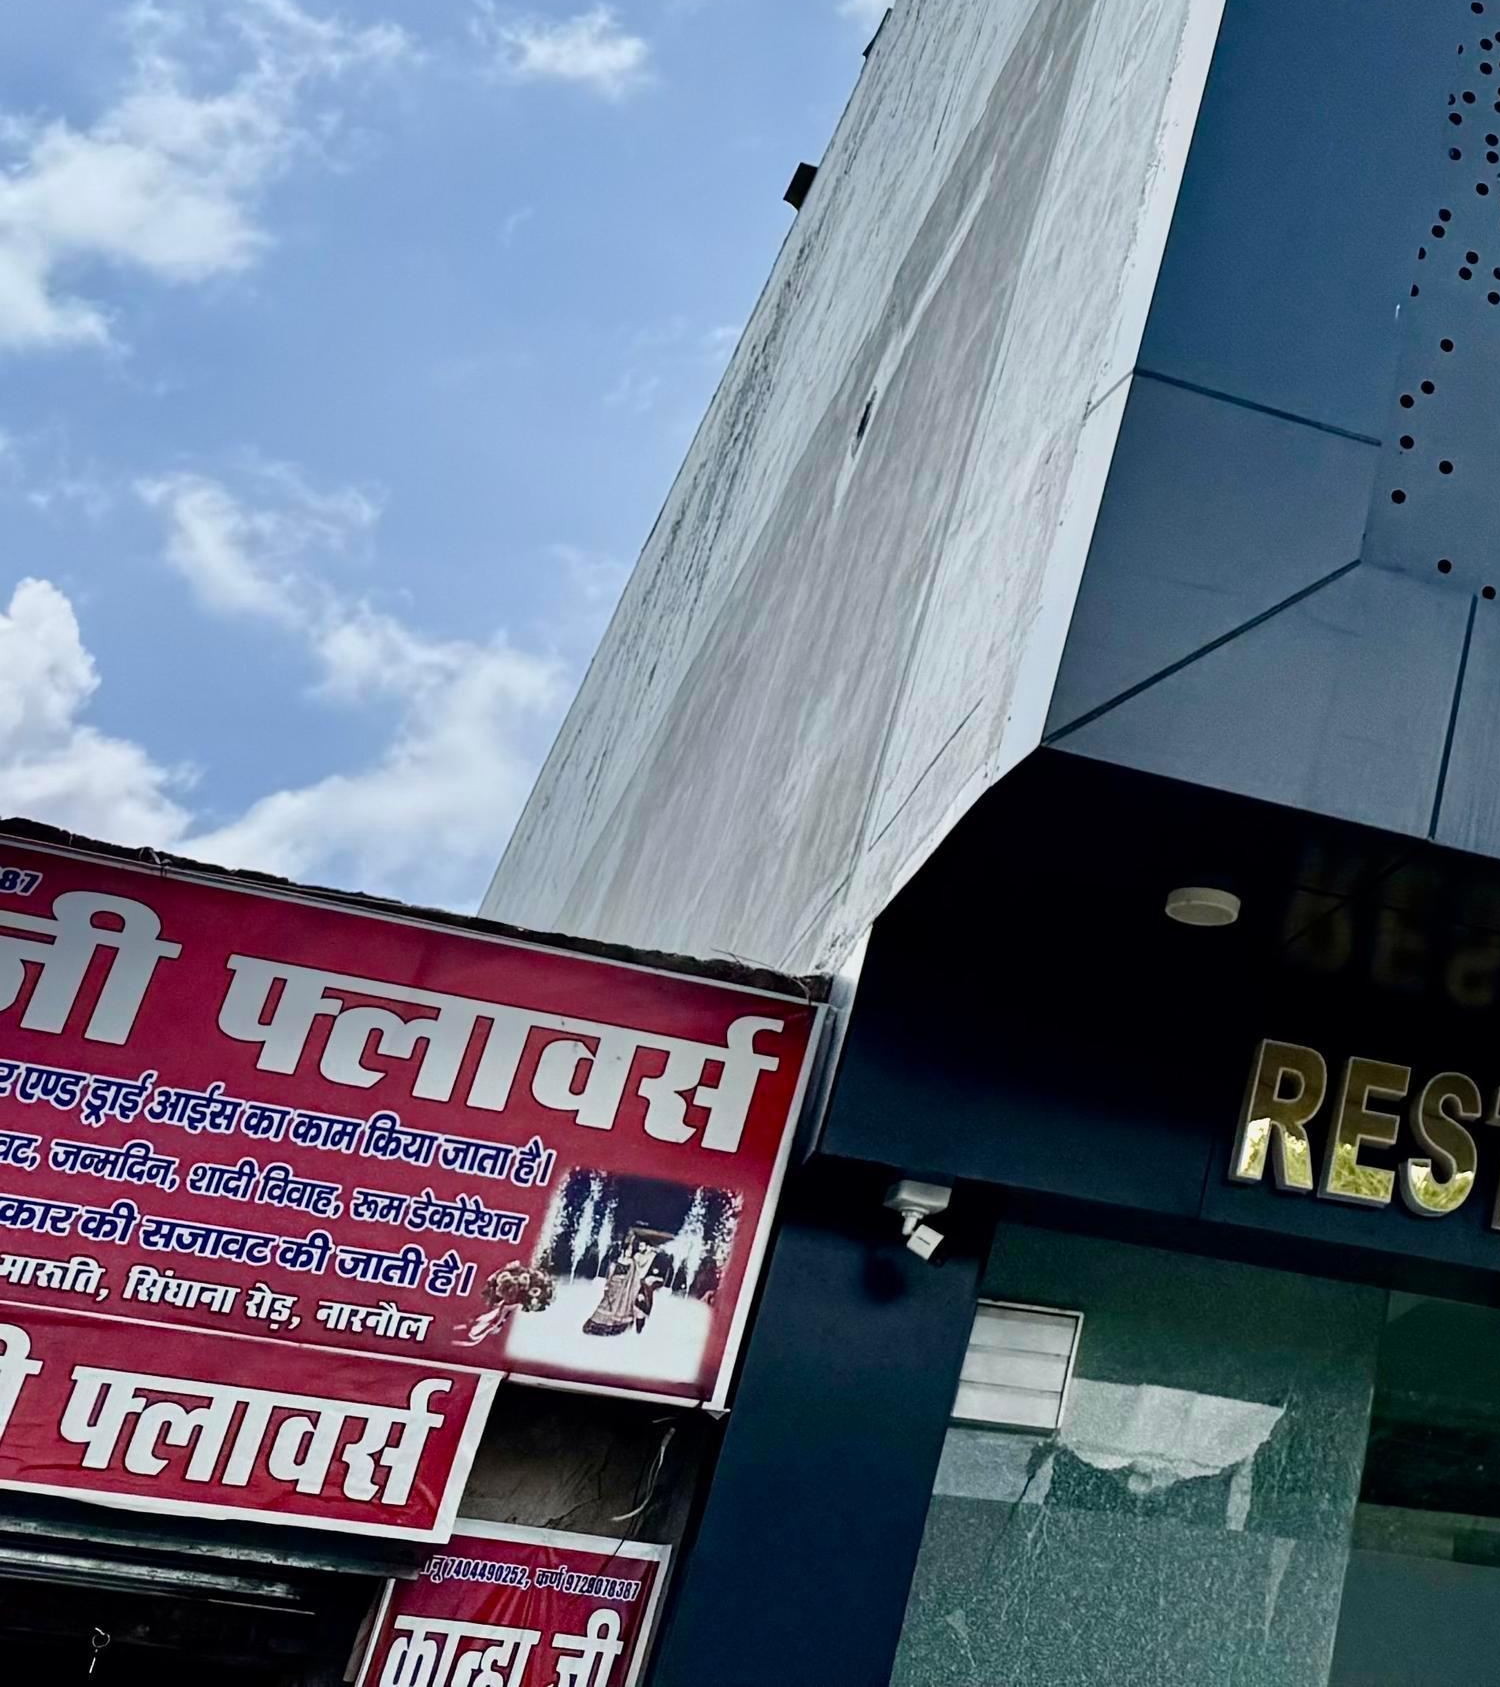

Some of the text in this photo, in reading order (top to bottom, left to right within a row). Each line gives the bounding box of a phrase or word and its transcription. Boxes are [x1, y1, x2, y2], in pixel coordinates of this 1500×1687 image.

[217, 952, 784, 1154] फ्लावर्स
[18, 1066, 86, 1110] एण्ड
[147, 1082, 246, 1133] आईस
[242, 1102, 293, 1142] का
[291, 1110, 361, 1154] काम
[360, 1110, 439, 1166] किया
[438, 1137, 515, 1178] जाता
[49, 1139, 180, 1193] जन्मदिन,
[187, 1158, 260, 1202] शादी
[255, 1162, 343, 1217] विवाह,
[350, 1187, 406, 1224] रूम
[406, 1187, 529, 1245] डेकोरेशन
[78, 1198, 138, 1245] की
[139, 1216, 279, 1266] सजावट
[276, 1229, 333, 1275] की
[335, 1243, 425, 1289] जाती
[122, 1263, 241, 1311] सिंघाना
[316, 1299, 434, 1342] नारनौल
[58, 1365, 454, 1506] फ्लावर्स
